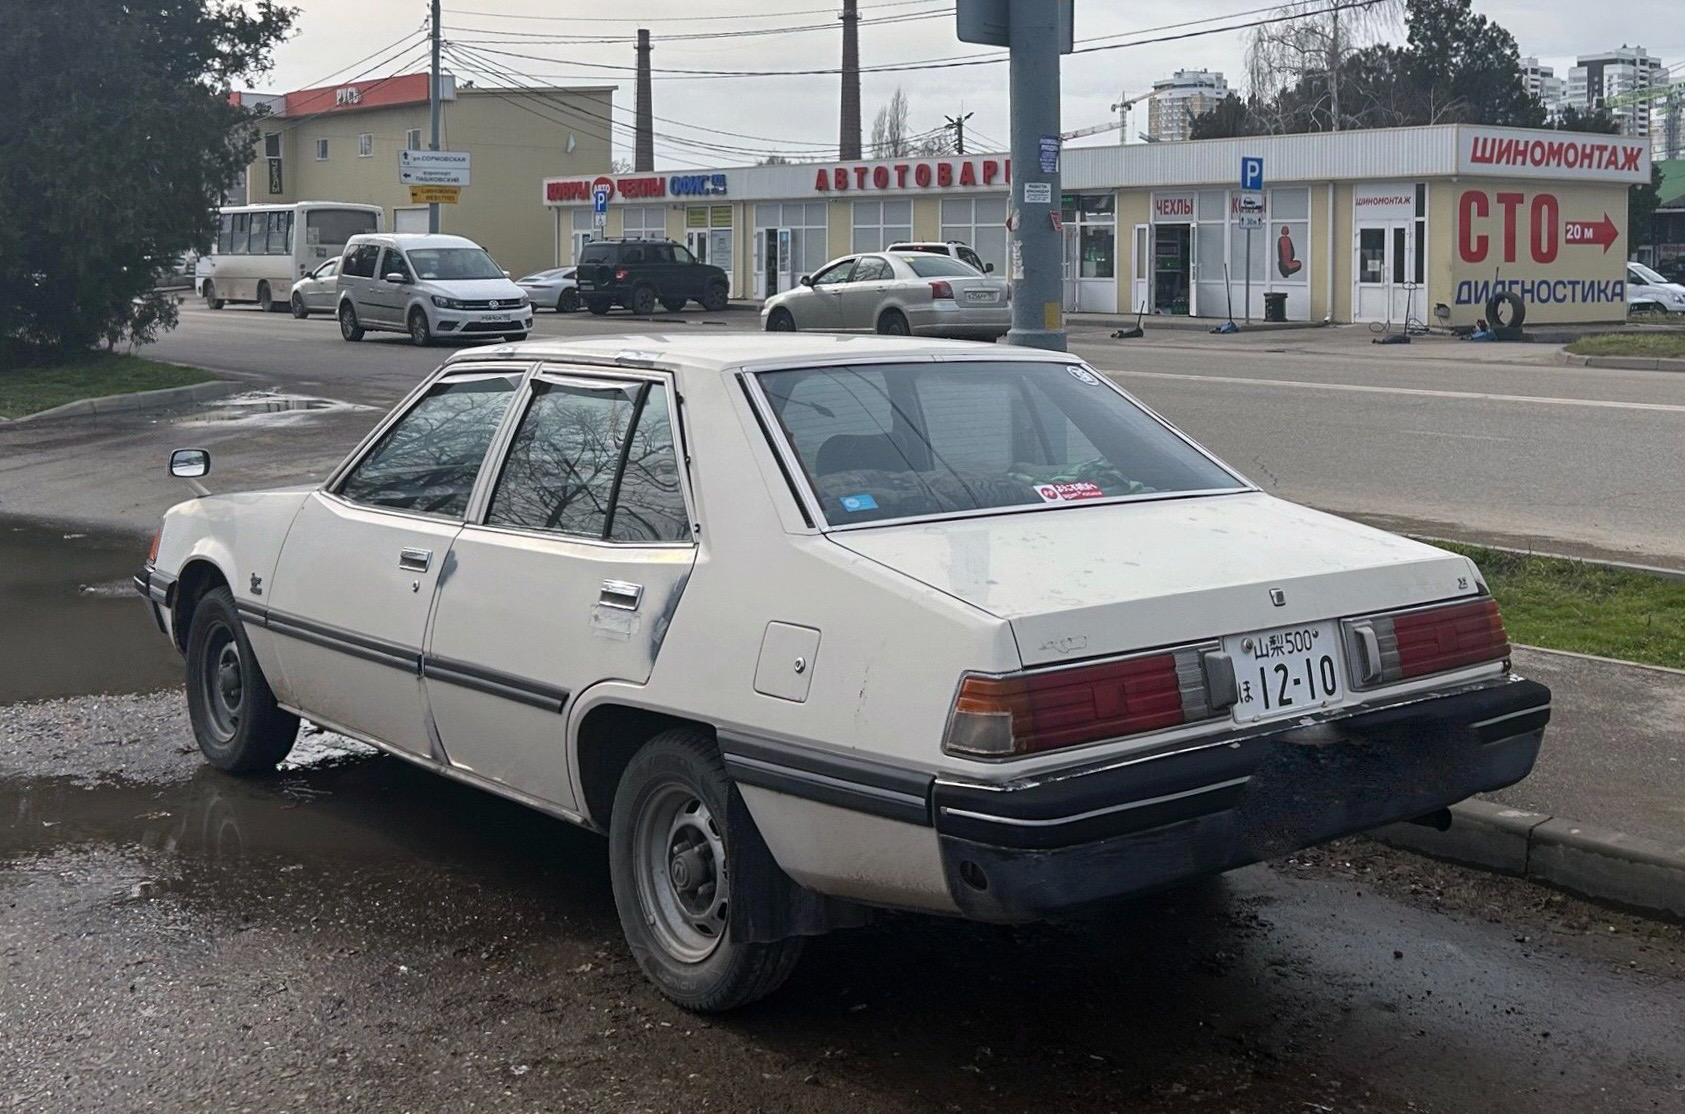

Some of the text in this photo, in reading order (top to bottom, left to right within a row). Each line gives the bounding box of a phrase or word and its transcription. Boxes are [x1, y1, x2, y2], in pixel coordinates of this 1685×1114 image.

[1470, 137, 1644, 172] ШИНОМОНТАЖ
[547, 181, 591, 201] КОВРЫ
[617, 177, 666, 199] ЧЕХЛЫ
[670, 175, 711, 196] ОФИС
[1355, 196, 1412, 206] ШИНОМОНТАЖ
[1156, 199, 1194, 215] ЧЕХЛЫ
[1458, 190, 1560, 264] СТО
[1566, 224, 1582, 240] 20
[1238, 655, 1337, 710] ほ 12-10
